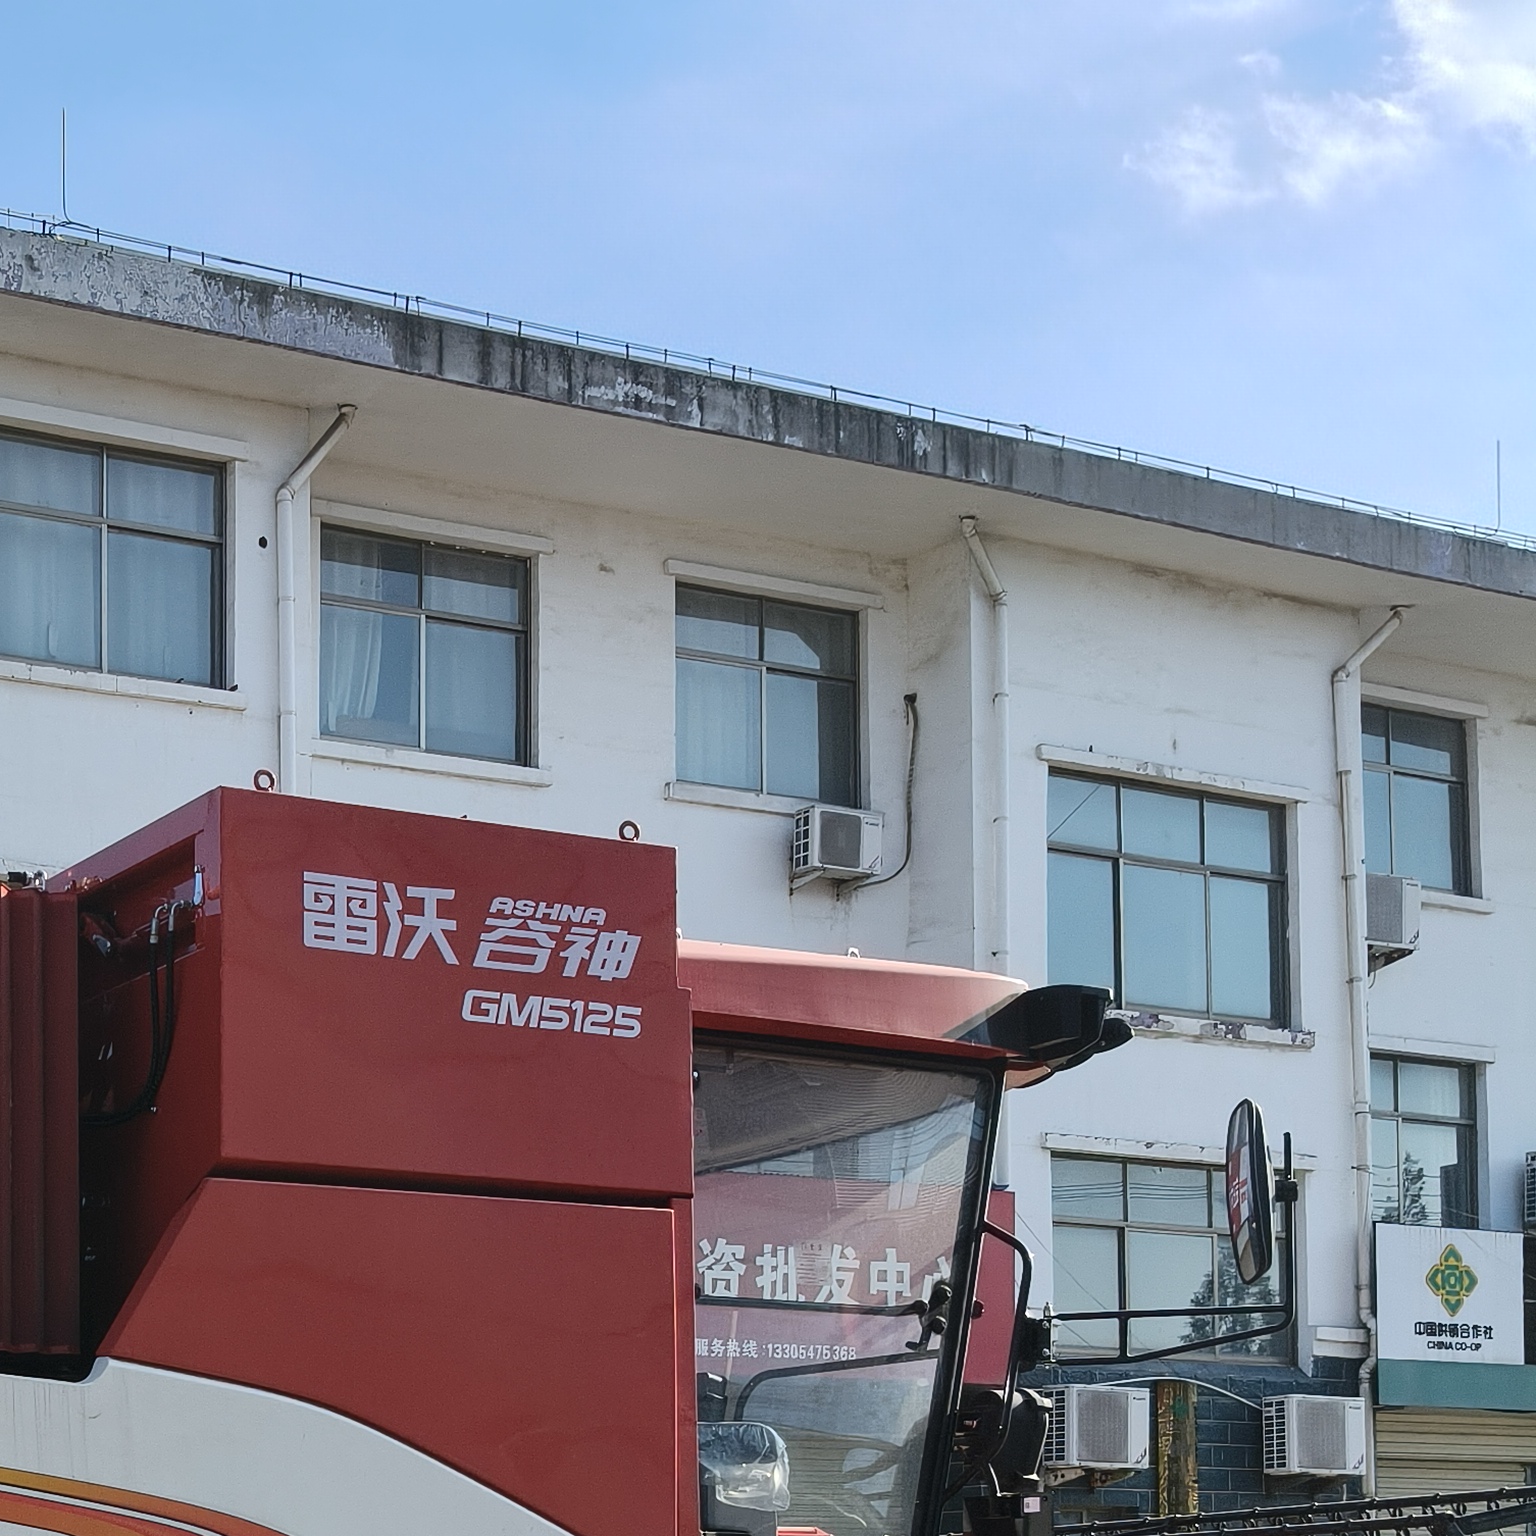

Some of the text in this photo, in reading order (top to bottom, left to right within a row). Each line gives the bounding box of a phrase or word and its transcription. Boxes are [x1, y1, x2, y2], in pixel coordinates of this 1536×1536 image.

[303, 871, 642, 981] 雷沃 谷神
[489, 896, 607, 926] ASHNA
[462, 989, 642, 1038] GM5125
[1414, 1321, 1494, 1340] 中国供销合作社
[1427, 1340, 1482, 1352] CHINA CO-OP
